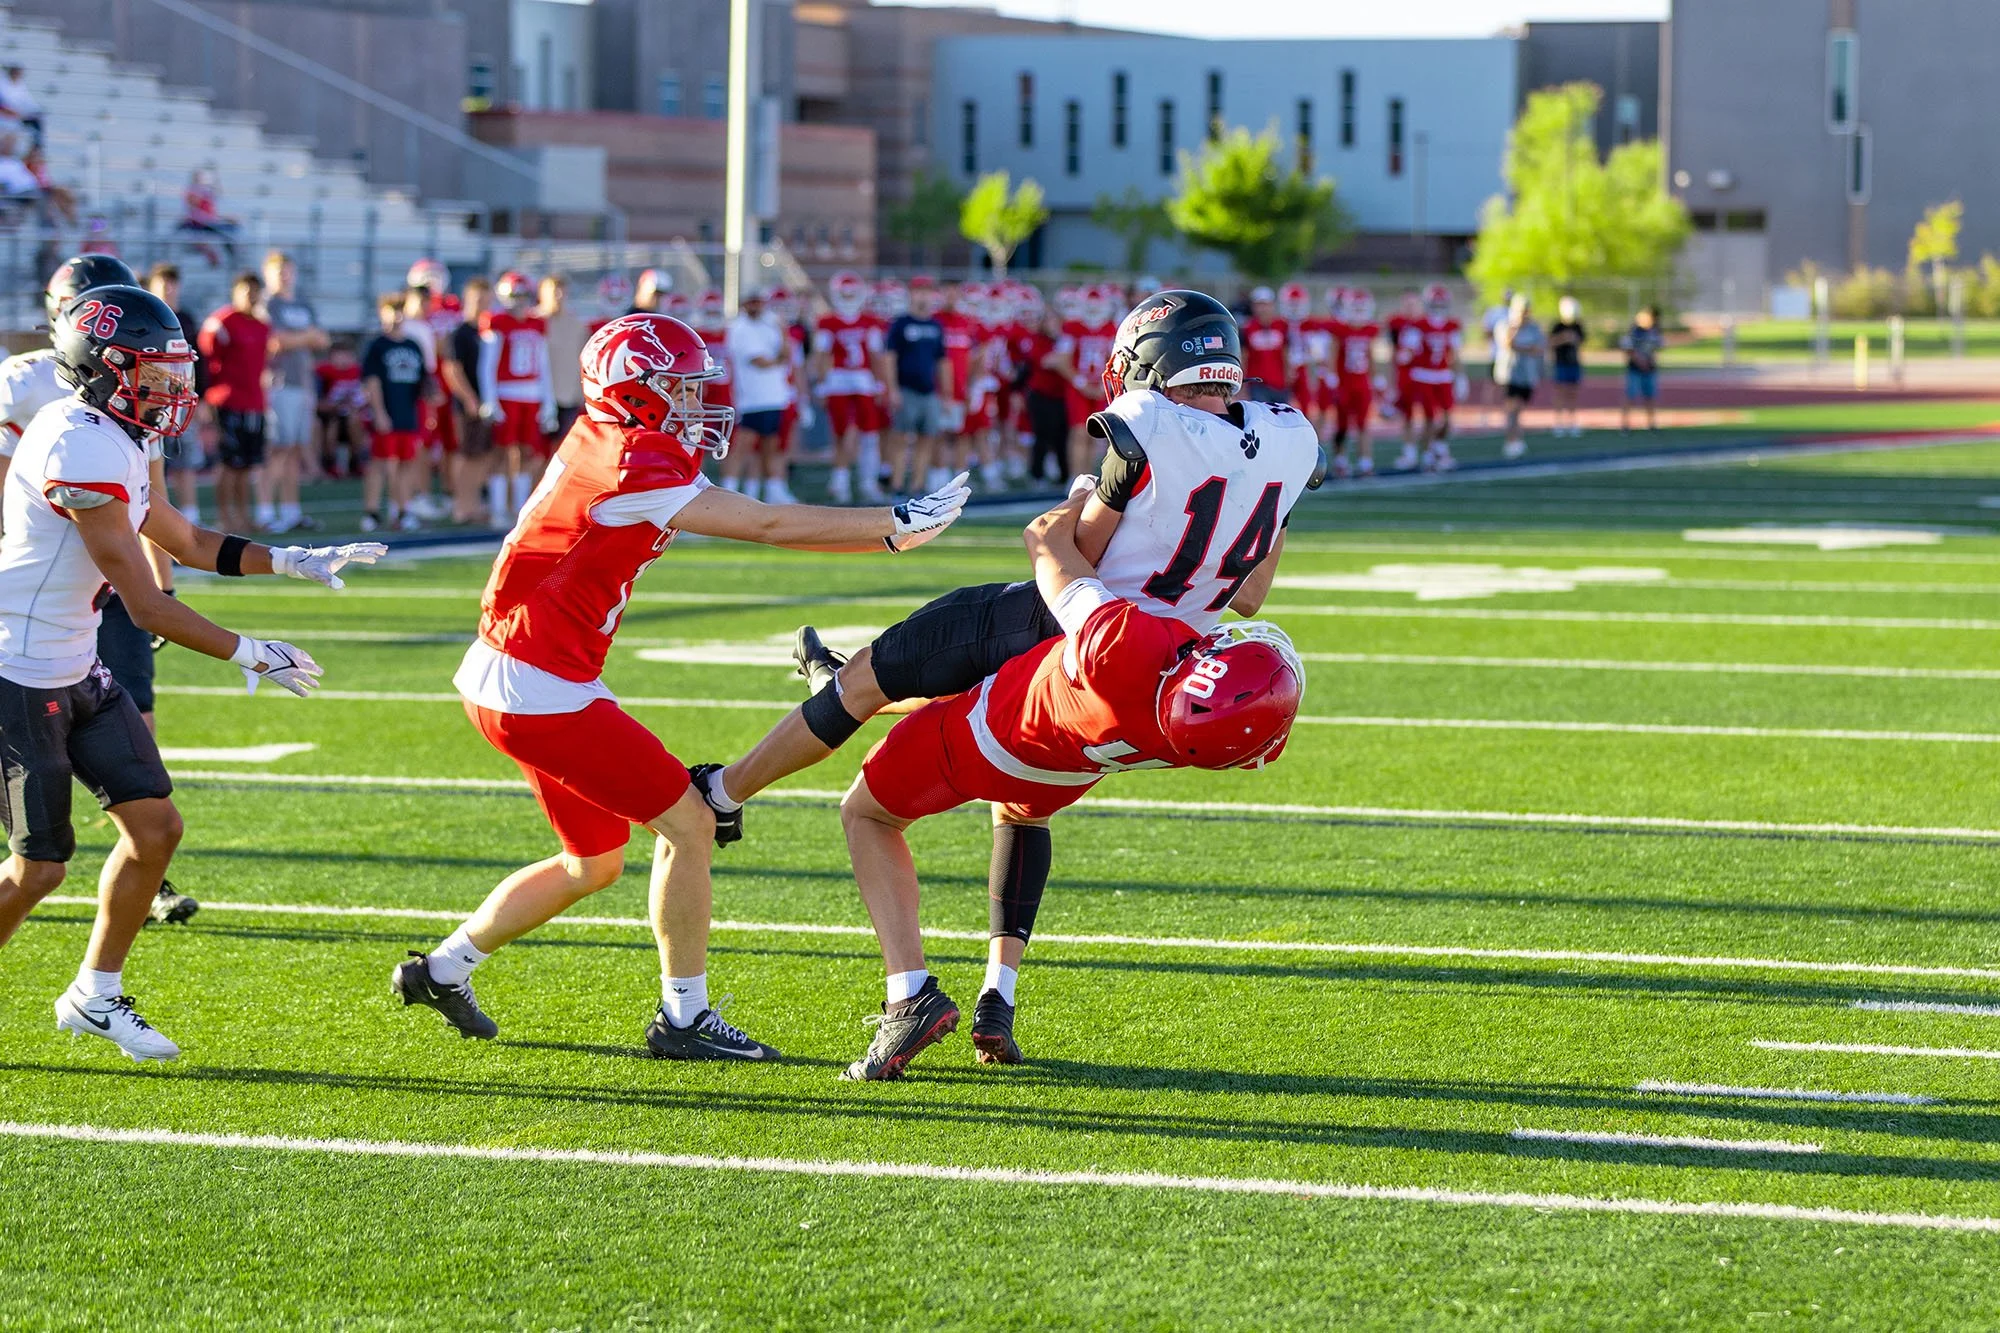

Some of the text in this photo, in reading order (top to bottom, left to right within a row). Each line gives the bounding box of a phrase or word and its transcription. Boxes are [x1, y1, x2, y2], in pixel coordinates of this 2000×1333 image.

[75, 300, 124, 339] 26
[84, 412, 100, 425] 3
[1141, 475, 1283, 612] 14
